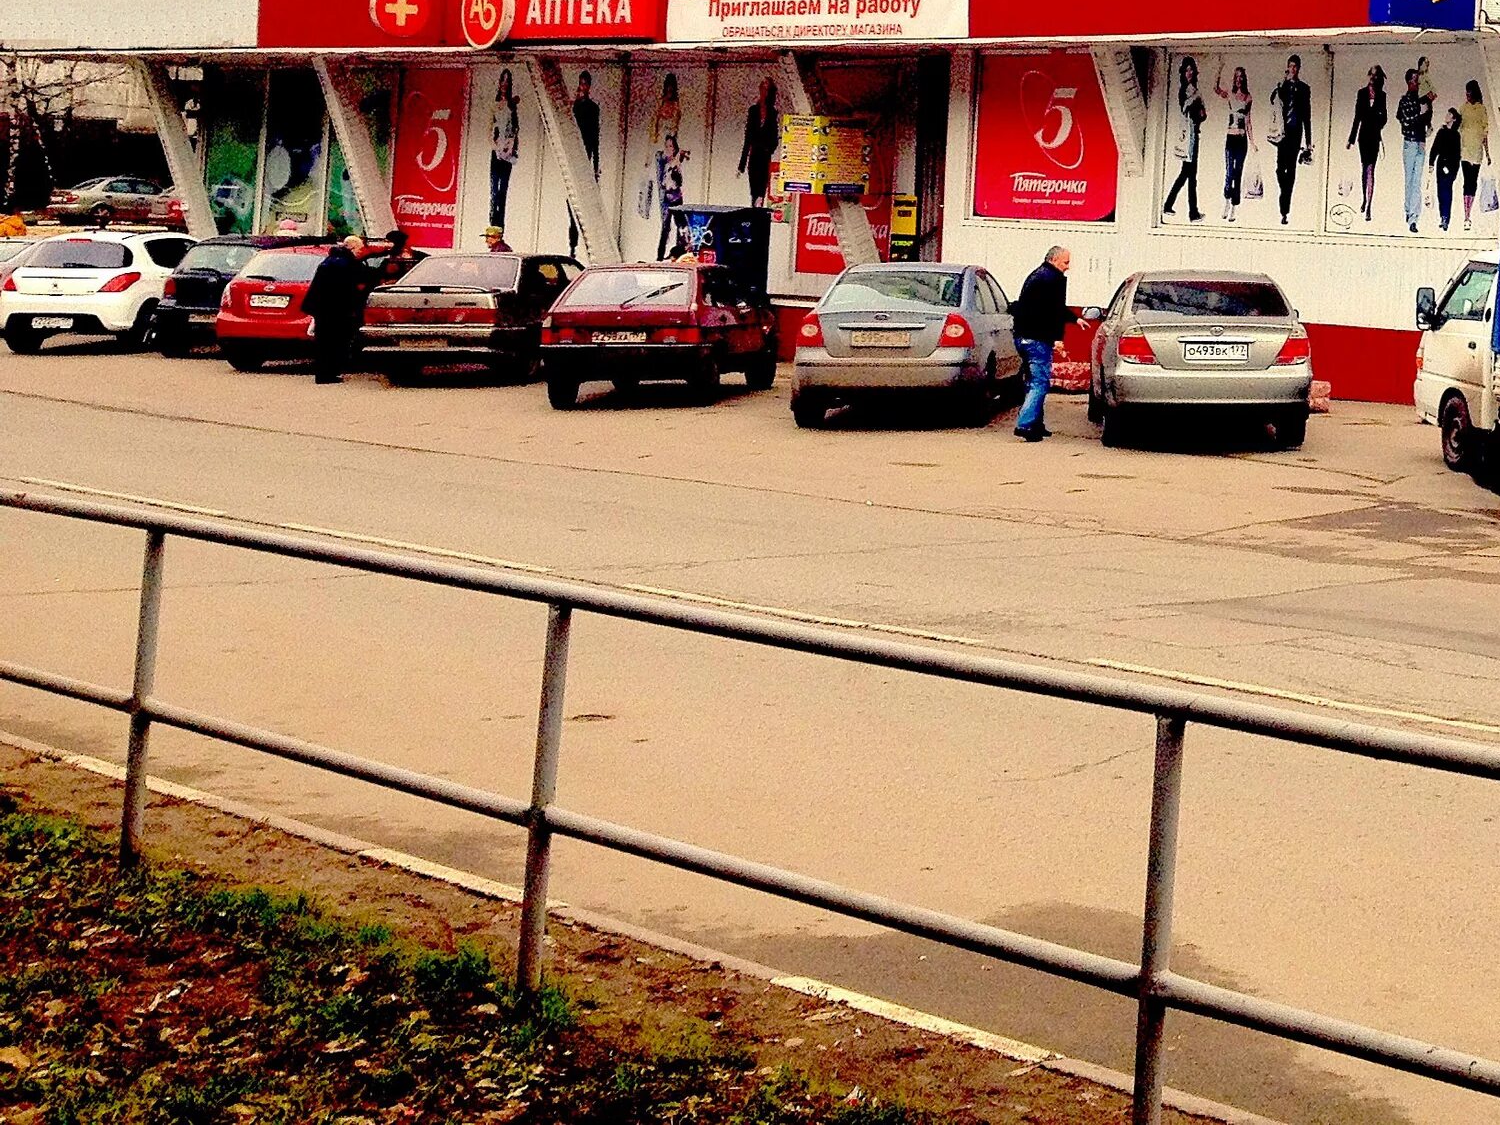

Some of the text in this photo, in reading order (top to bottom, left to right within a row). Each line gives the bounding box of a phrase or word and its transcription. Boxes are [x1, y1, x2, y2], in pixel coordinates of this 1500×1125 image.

[722, 23, 903, 38] ОБРАЩАТЬСЯ К ДИРЕКТОРУ МАГАЗИНА
[415, 109, 452, 172] 5
[1033, 87, 1078, 150] 5
[1009, 171, 1088, 197] Пятерочка
